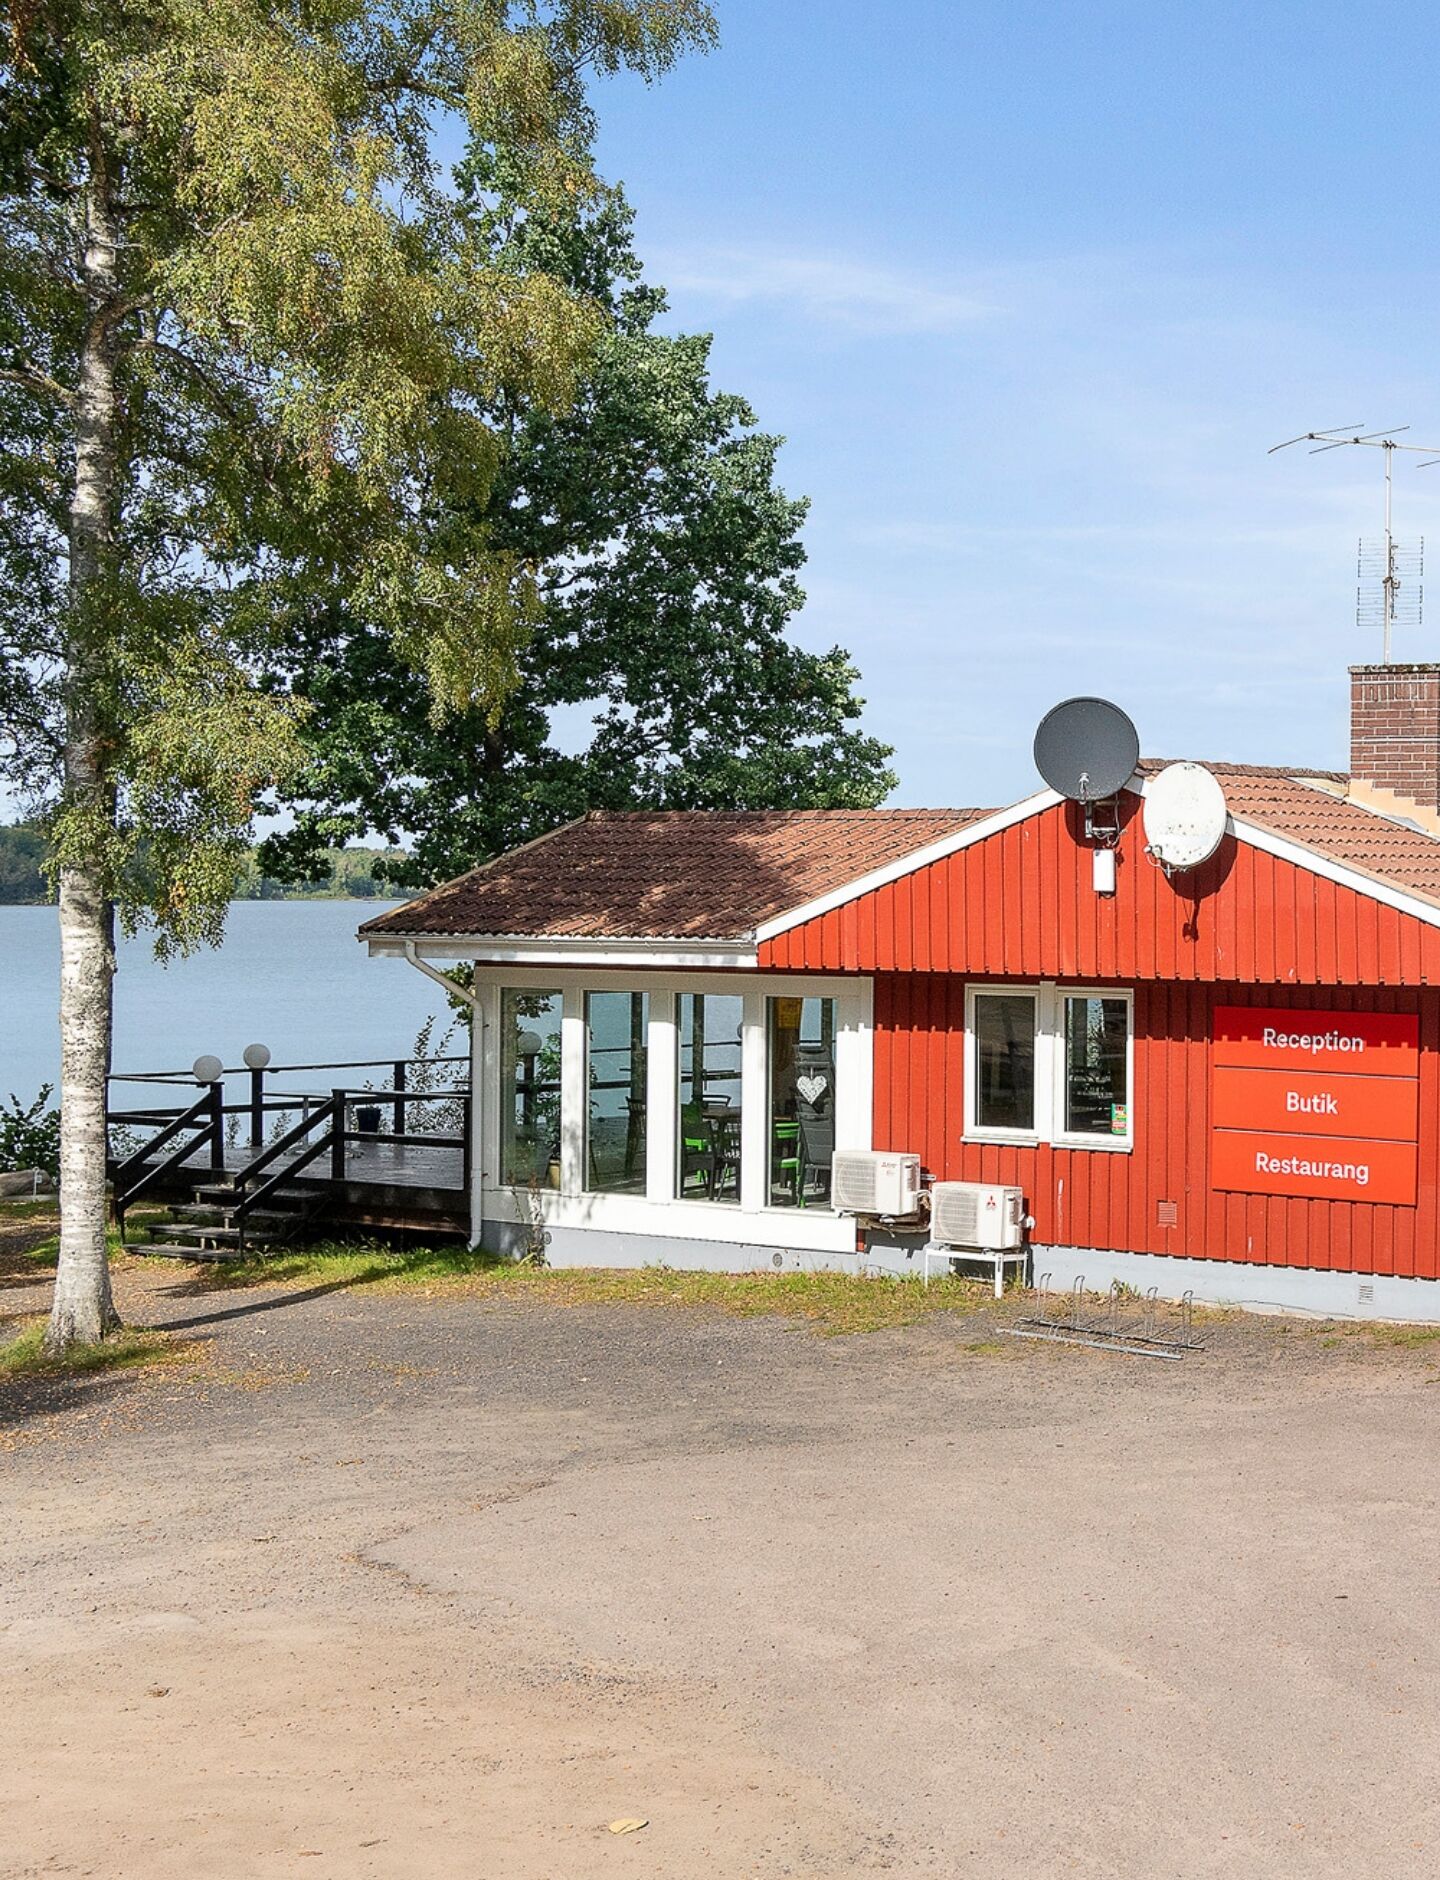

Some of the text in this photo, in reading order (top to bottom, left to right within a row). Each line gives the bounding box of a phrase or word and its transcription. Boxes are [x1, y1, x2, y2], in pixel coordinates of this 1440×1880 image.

[1263, 1028, 1364, 1055] Reception
[1286, 1091, 1338, 1115] Butik
[1255, 1152, 1370, 1185] Restaurang
